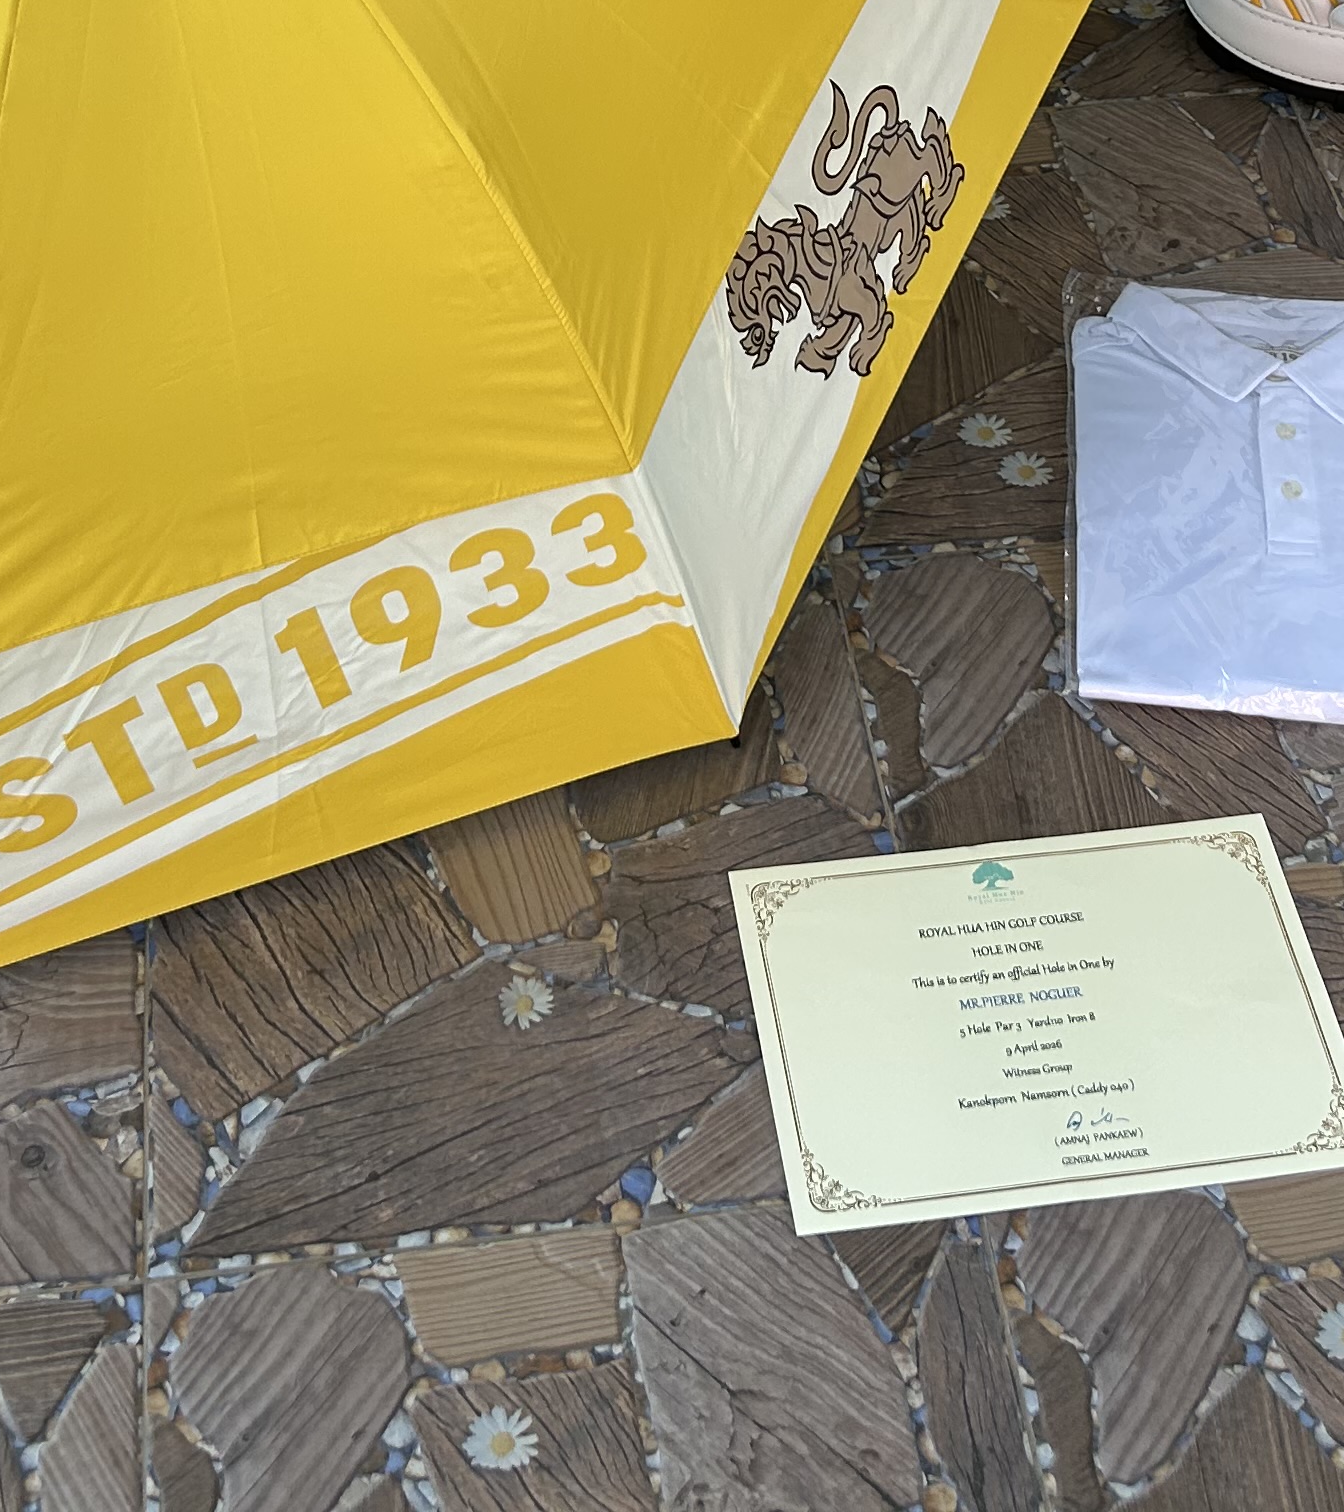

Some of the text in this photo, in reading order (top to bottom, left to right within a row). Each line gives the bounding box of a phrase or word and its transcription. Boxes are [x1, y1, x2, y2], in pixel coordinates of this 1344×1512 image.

[276, 492, 647, 710] 1933
[918, 911, 1085, 939] ROYAL HUA HIN GOLF COURSE
[971, 940, 1044, 958] HOLE IN ONE
[912, 955, 1115, 989] This is to certify an official Hole in One by
[967, 1021, 992, 1035] Hole
[995, 1021, 1015, 1033] Par
[1015, 1022, 1023, 1032] 3
[1067, 1013, 1088, 1024] Iron
[1014, 1040, 1039, 1056] April
[1040, 1039, 1063, 1051] 2026
[1002, 1063, 1073, 1079] Witness Group
[1061, 1147, 1151, 1166] GENERAL MANAGER
